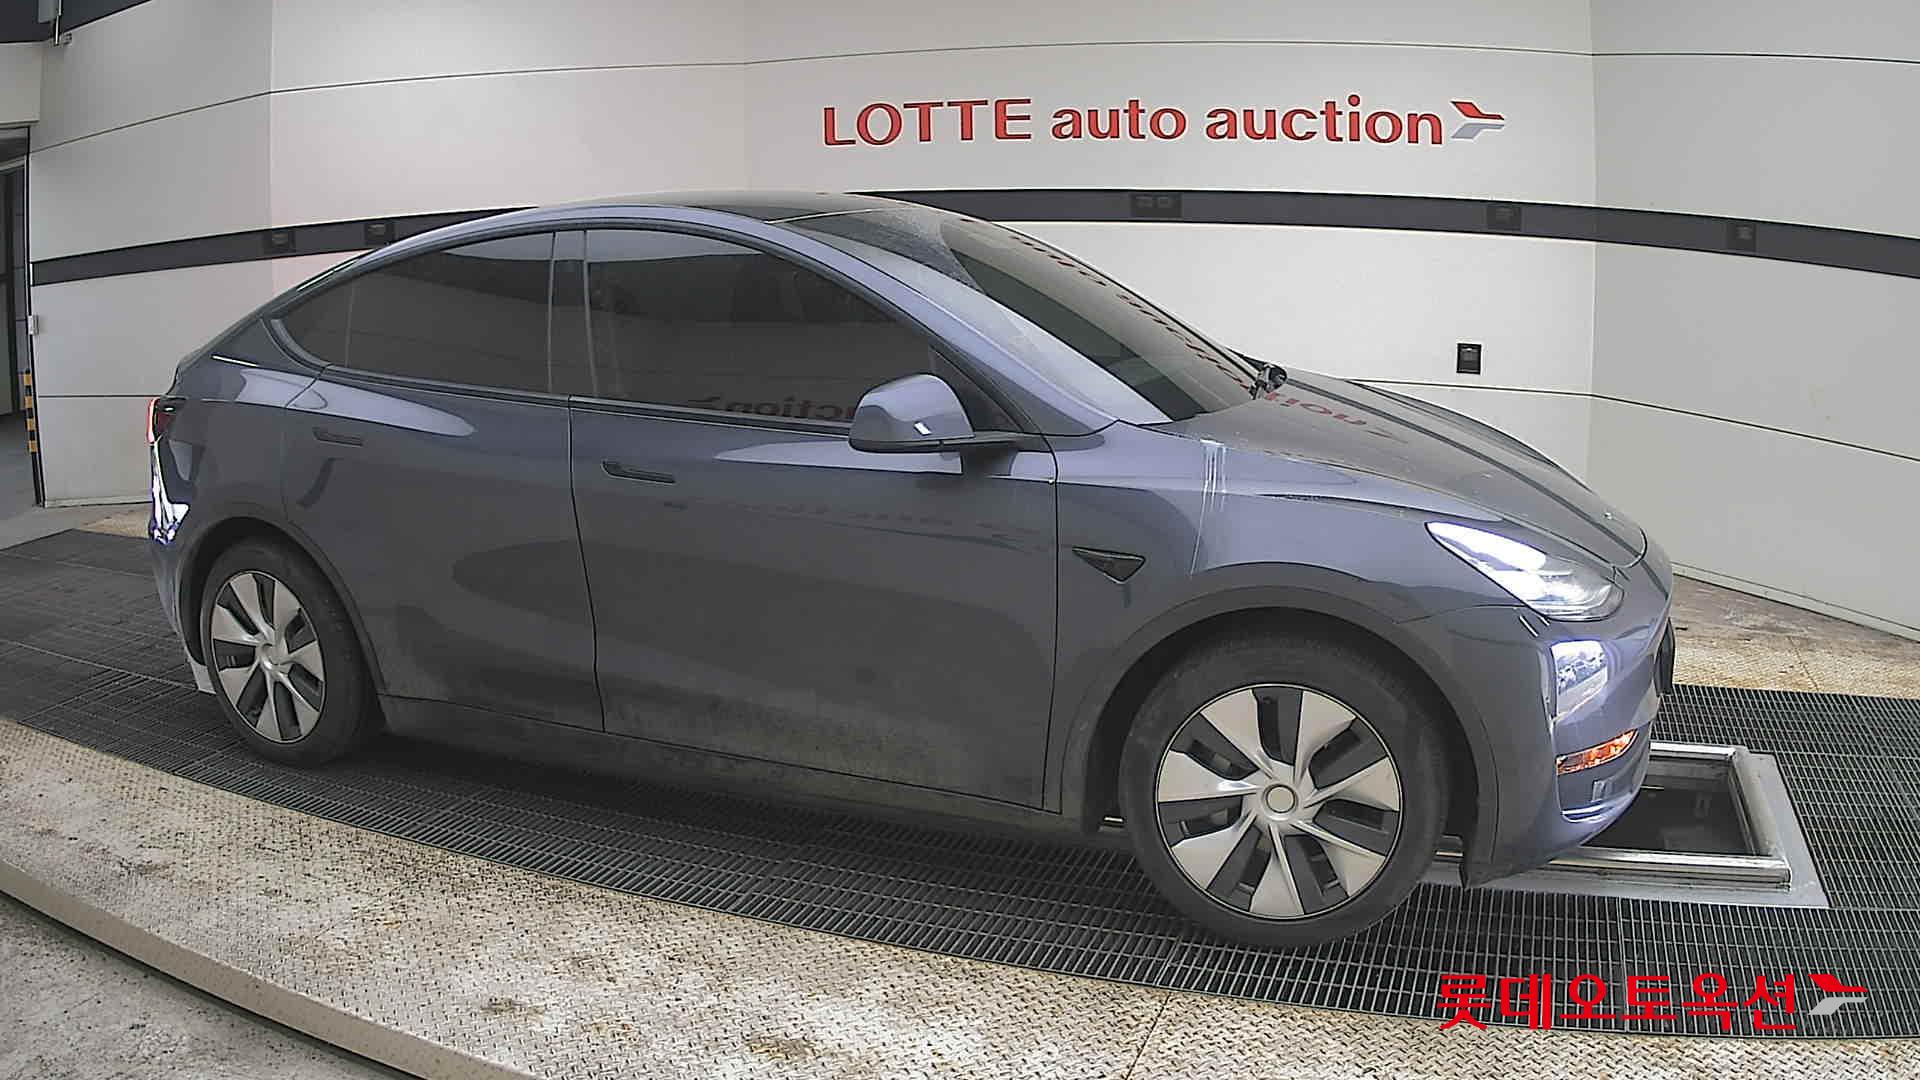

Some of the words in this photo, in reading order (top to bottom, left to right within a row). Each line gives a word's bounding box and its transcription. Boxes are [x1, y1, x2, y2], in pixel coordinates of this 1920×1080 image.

[822, 98, 1033, 146] LOTTE
[1051, 99, 1188, 140] auto
[1205, 94, 1444, 145] auction
